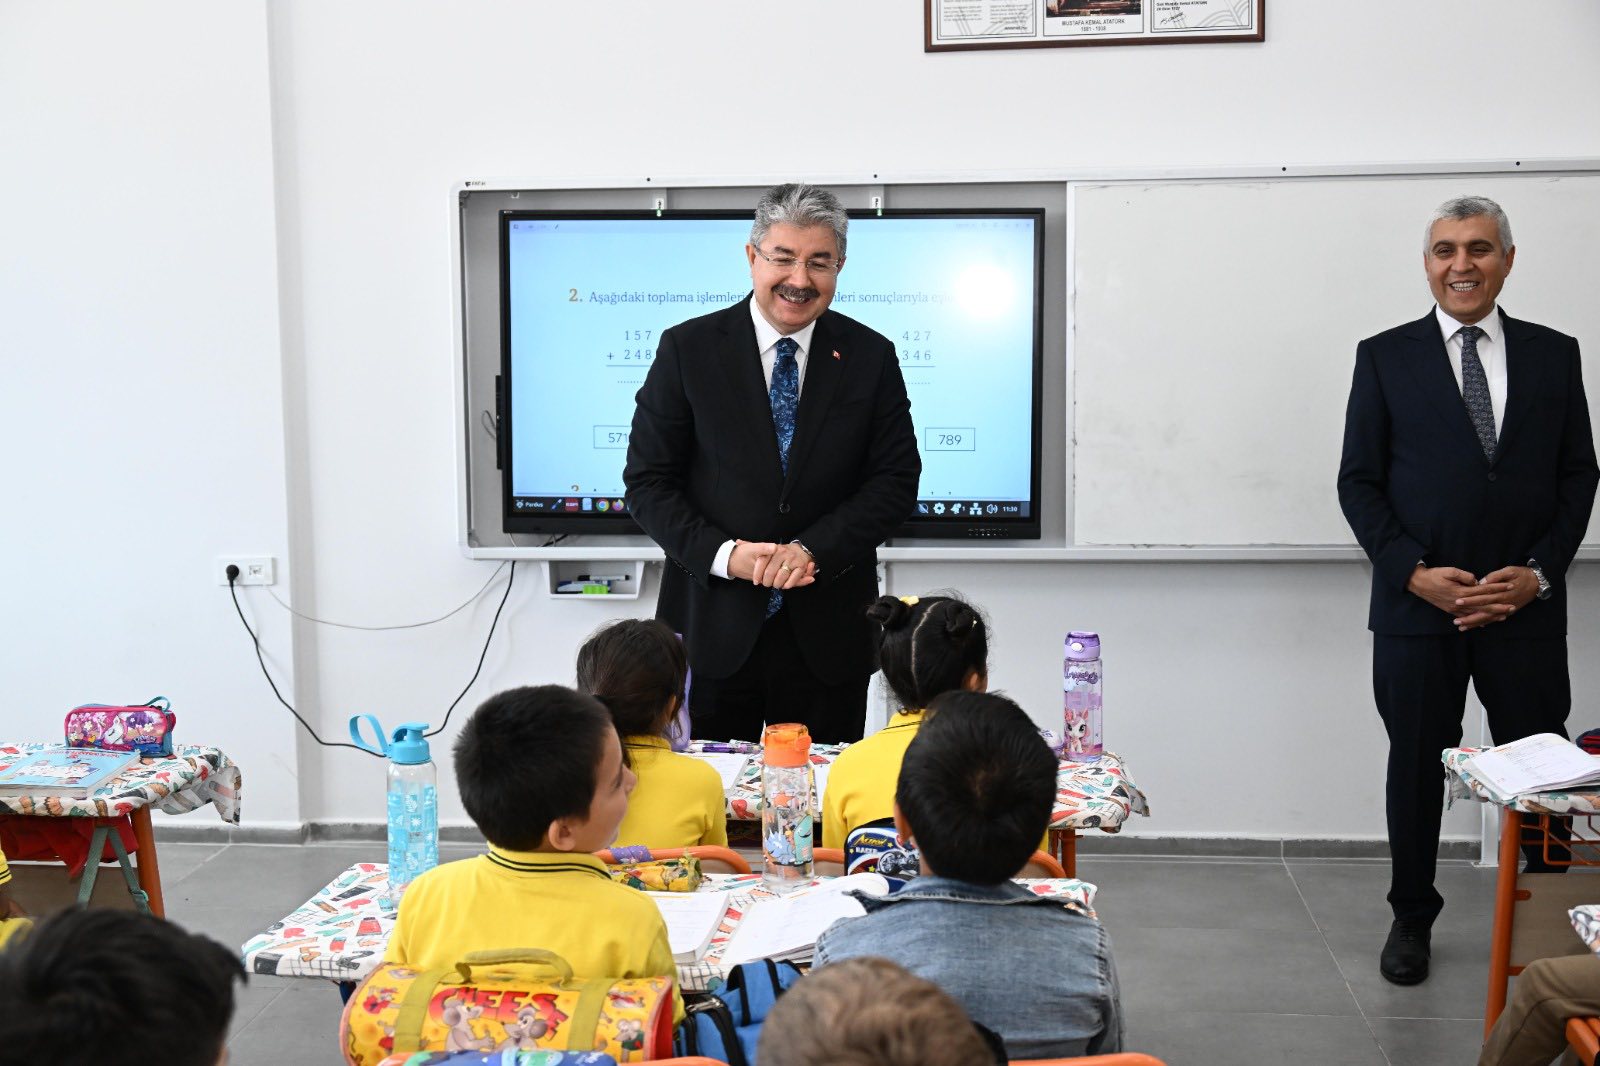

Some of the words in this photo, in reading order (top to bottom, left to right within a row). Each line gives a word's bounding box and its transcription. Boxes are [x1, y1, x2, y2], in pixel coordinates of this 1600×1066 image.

[568, 289, 584, 303] 2.
[589, 290, 646, 305] Aşağıdaki
[647, 291, 694, 305] toplama
[858, 291, 929, 305] sonuçlarıyla
[938, 434, 962, 446] 789
